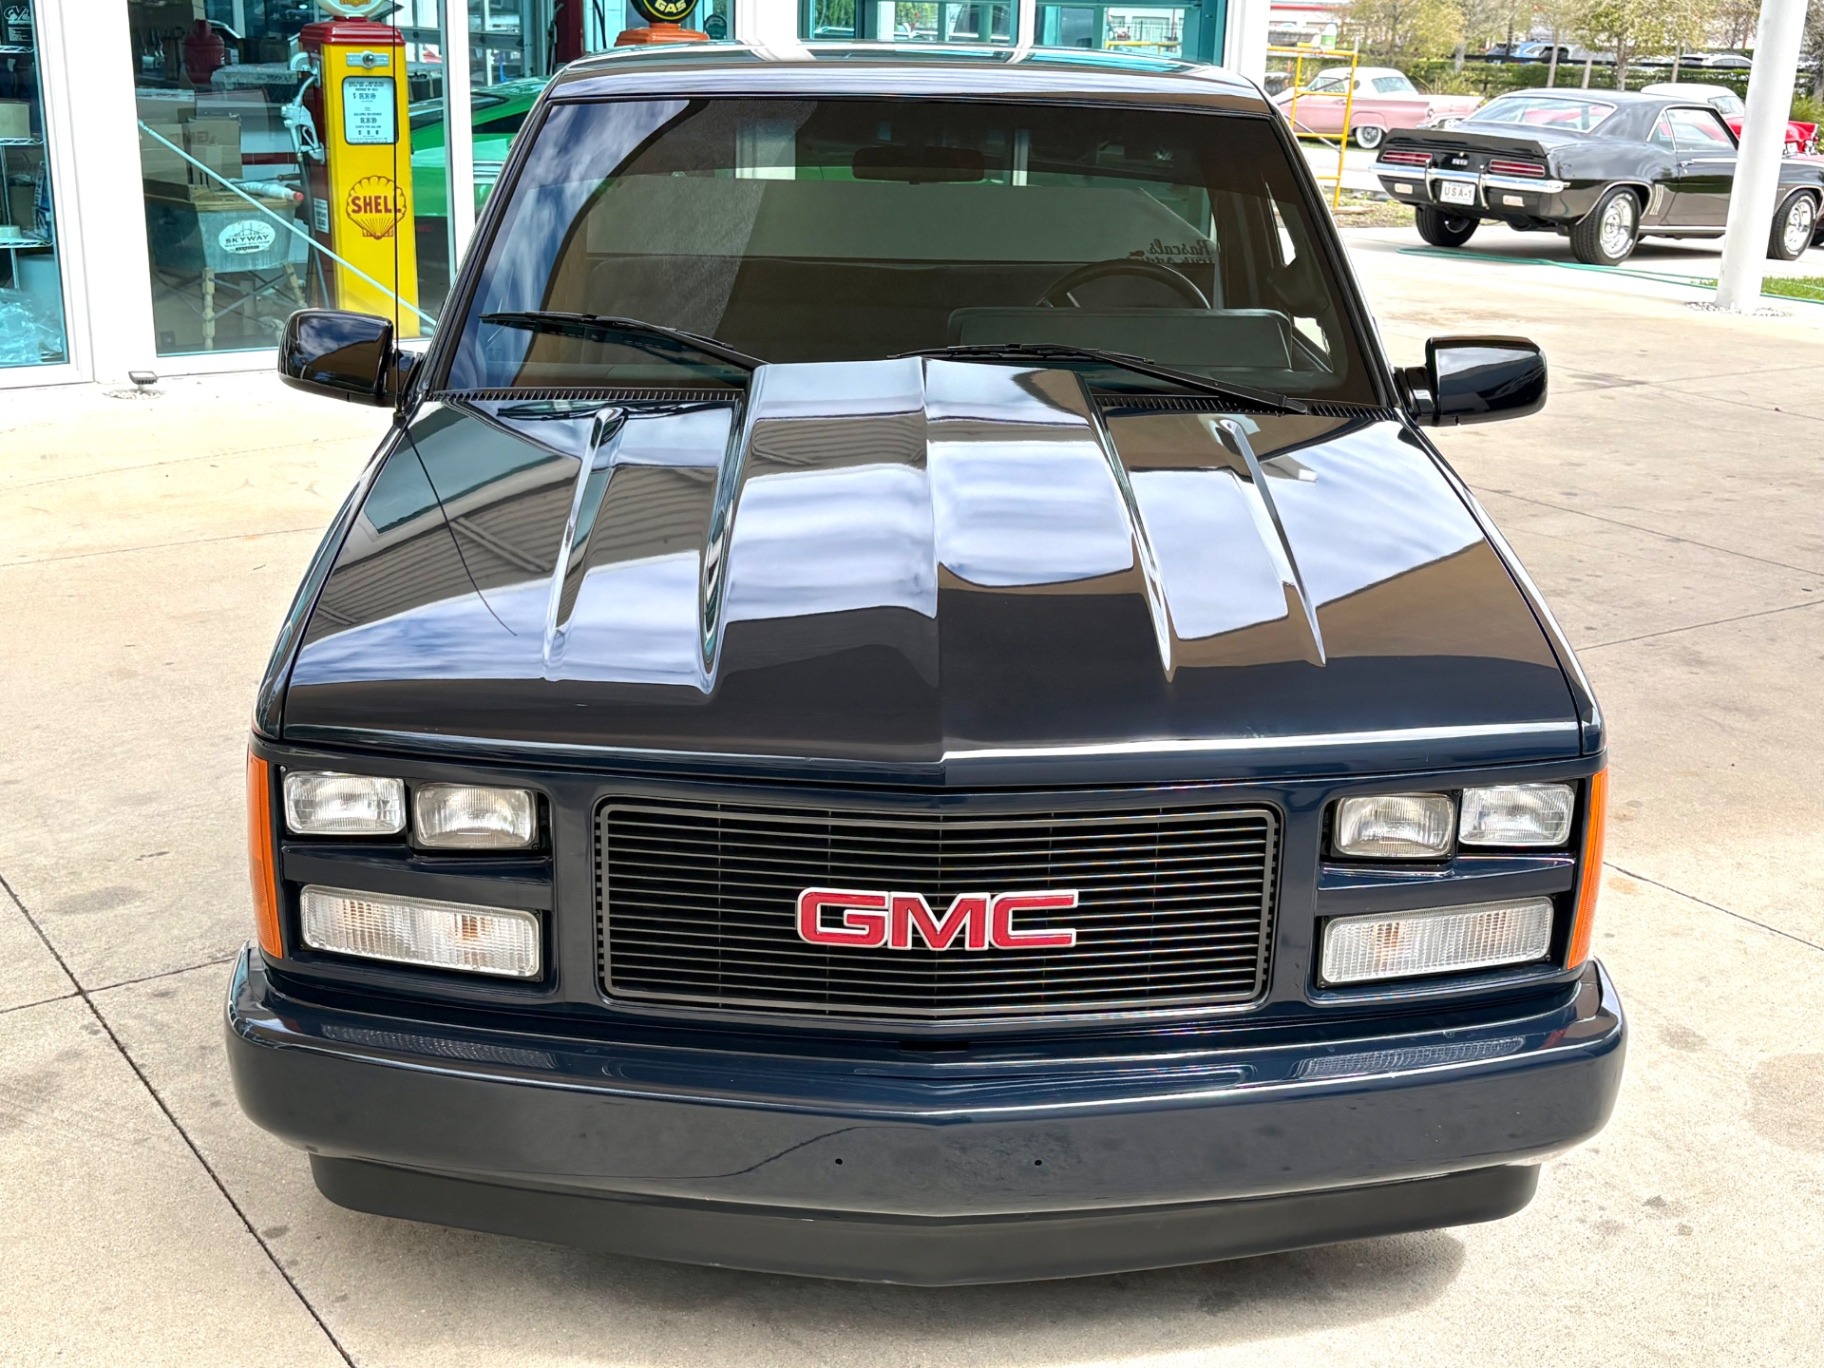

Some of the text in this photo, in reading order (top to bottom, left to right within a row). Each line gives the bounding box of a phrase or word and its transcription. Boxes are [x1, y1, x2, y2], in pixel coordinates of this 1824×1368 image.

[654, 0, 686, 13] GAS
[225, 234, 269, 244] SKYWAY
[797, 887, 1079, 951] GMC
